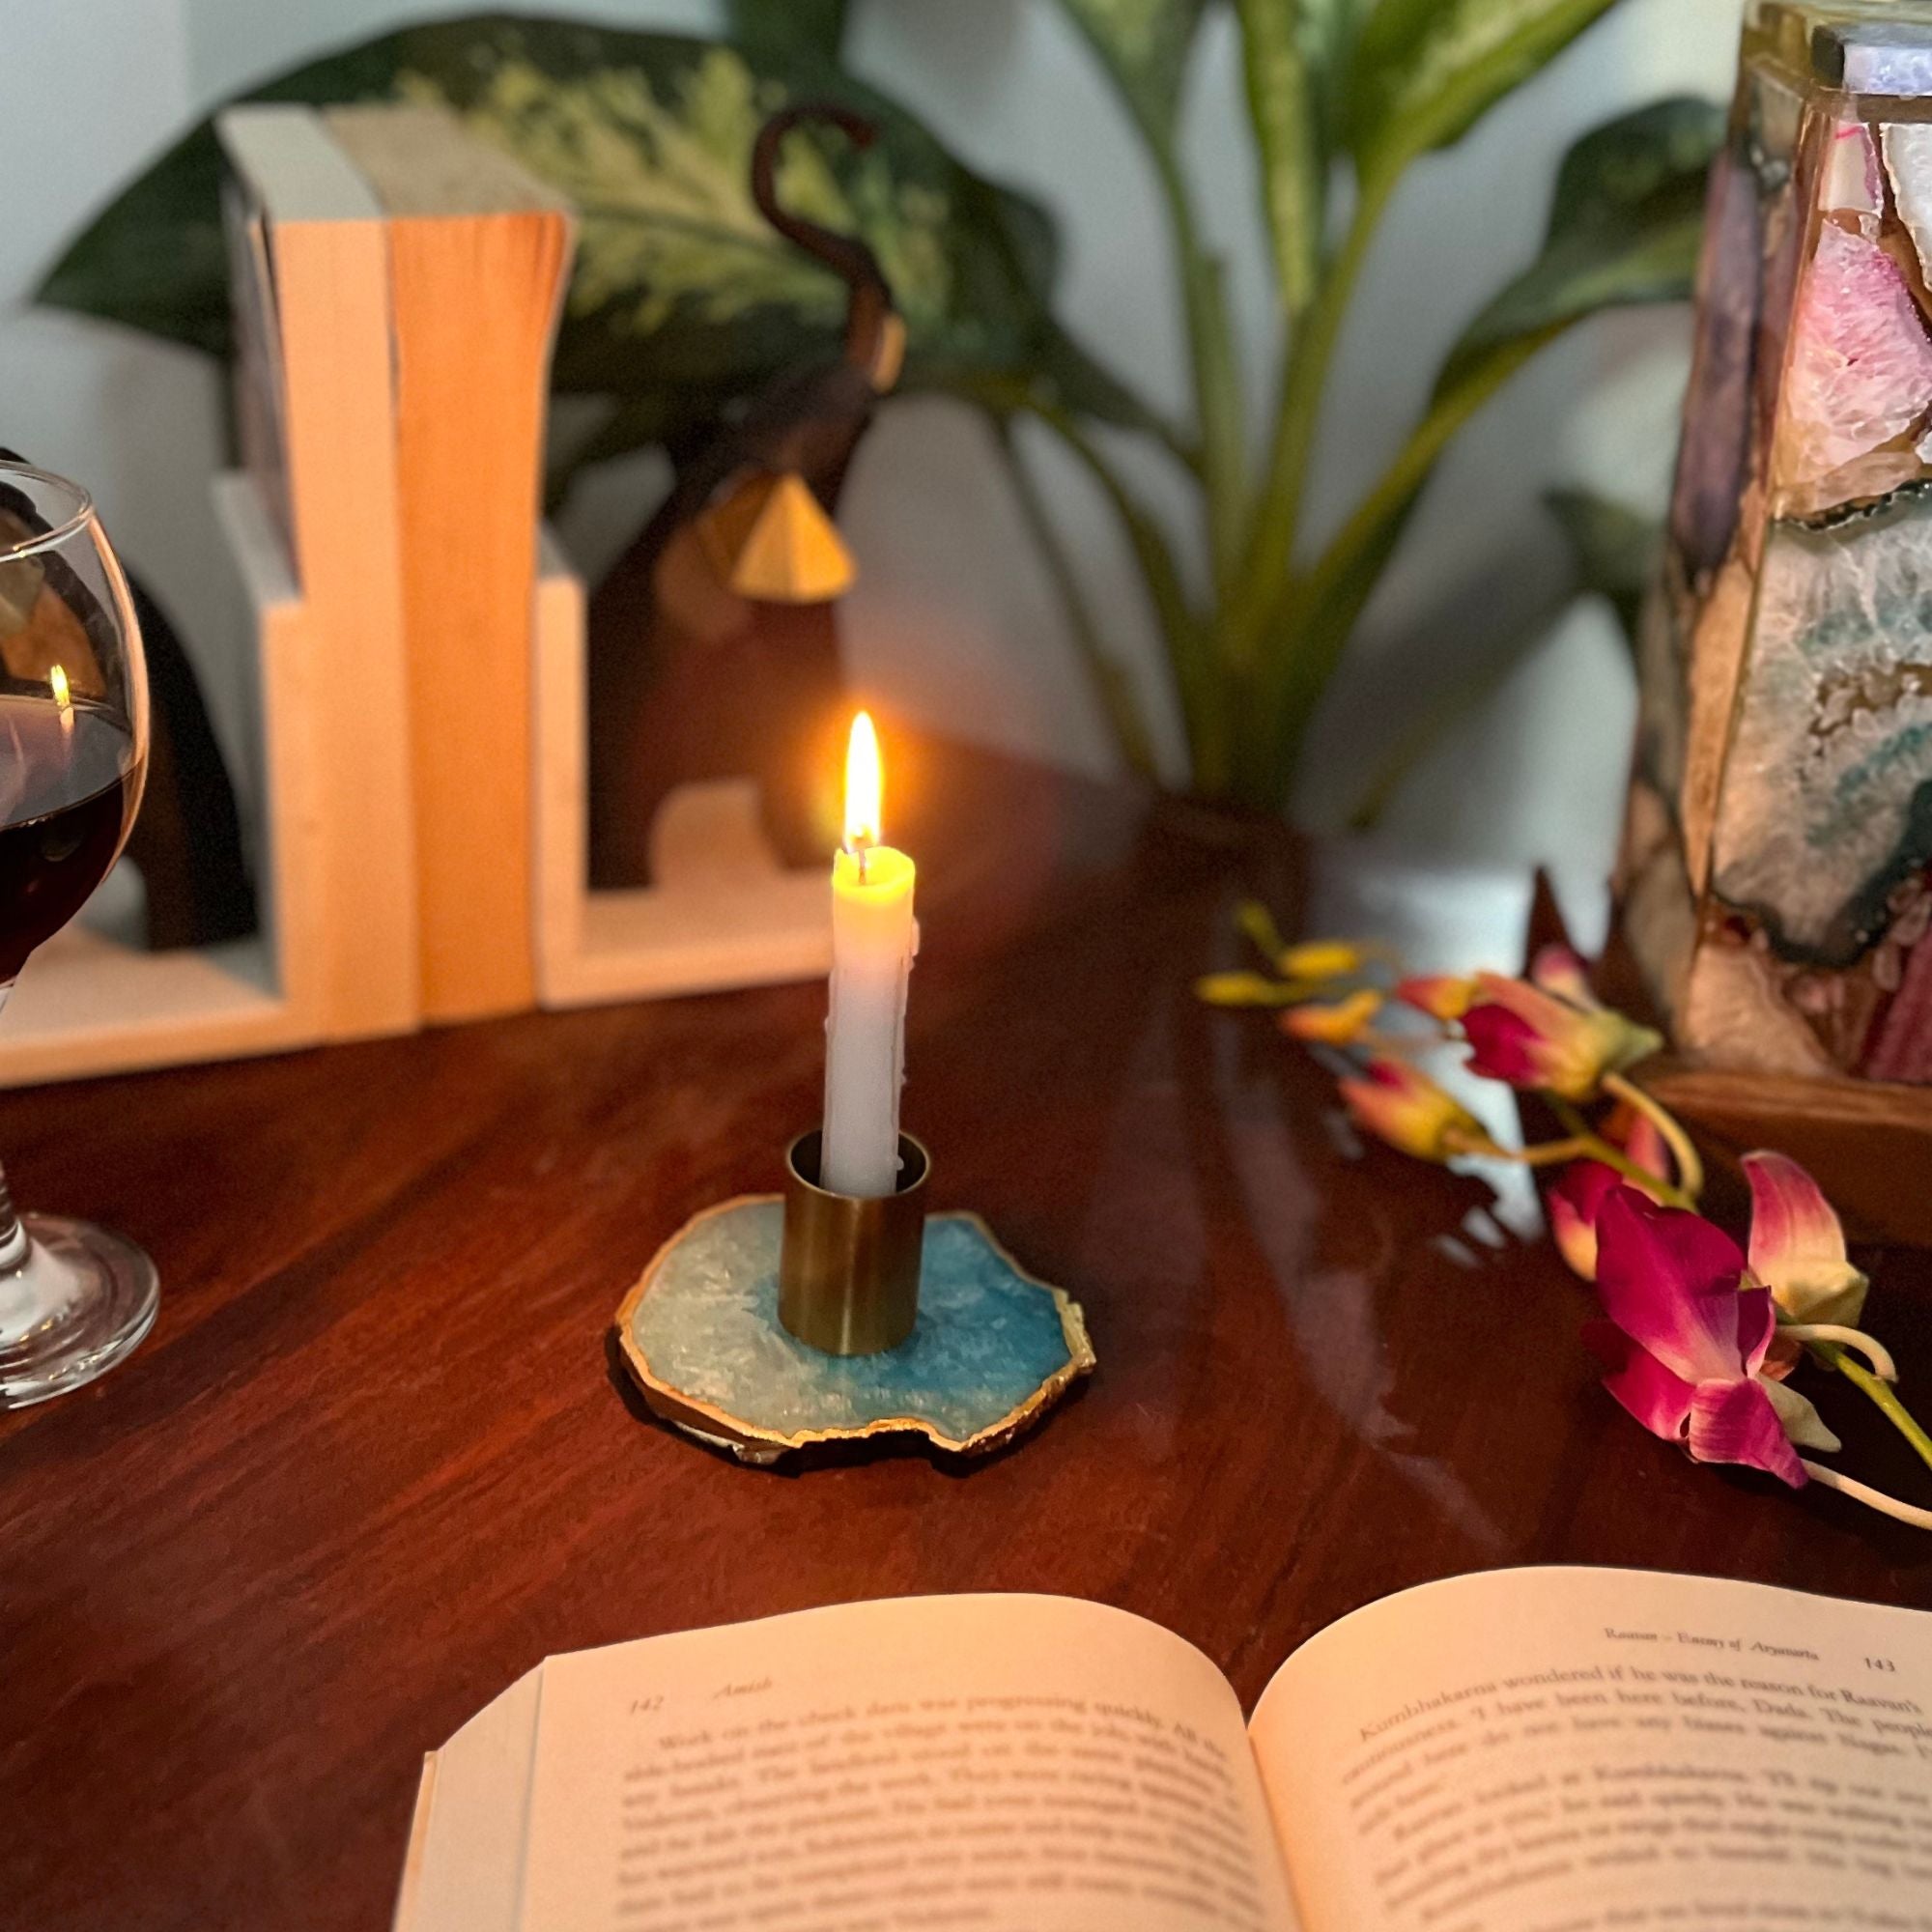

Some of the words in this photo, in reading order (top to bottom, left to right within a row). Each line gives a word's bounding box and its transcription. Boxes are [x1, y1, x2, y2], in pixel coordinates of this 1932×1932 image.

[1728, 1639, 1741, 1652] of
[1864, 1657, 1896, 1672] 143
[713, 1676, 773, 1699] Amish
[630, 1695, 665, 1716] 142
[1359, 1682, 1498, 1742] Kumbhakarna
[1502, 1665, 1604, 1690] wondered
[1608, 1664, 1623, 1680] if
[1629, 1665, 1657, 1682] he
[1662, 1671, 1699, 1685] was
[1703, 1671, 1735, 1688] the
[1740, 1678, 1804, 1696] reason
[1806, 1685, 1837, 1701] for
[1497, 1698, 1546, 1717] have
[1554, 1691, 1608, 1707] been
[1615, 1689, 1662, 1705] here
